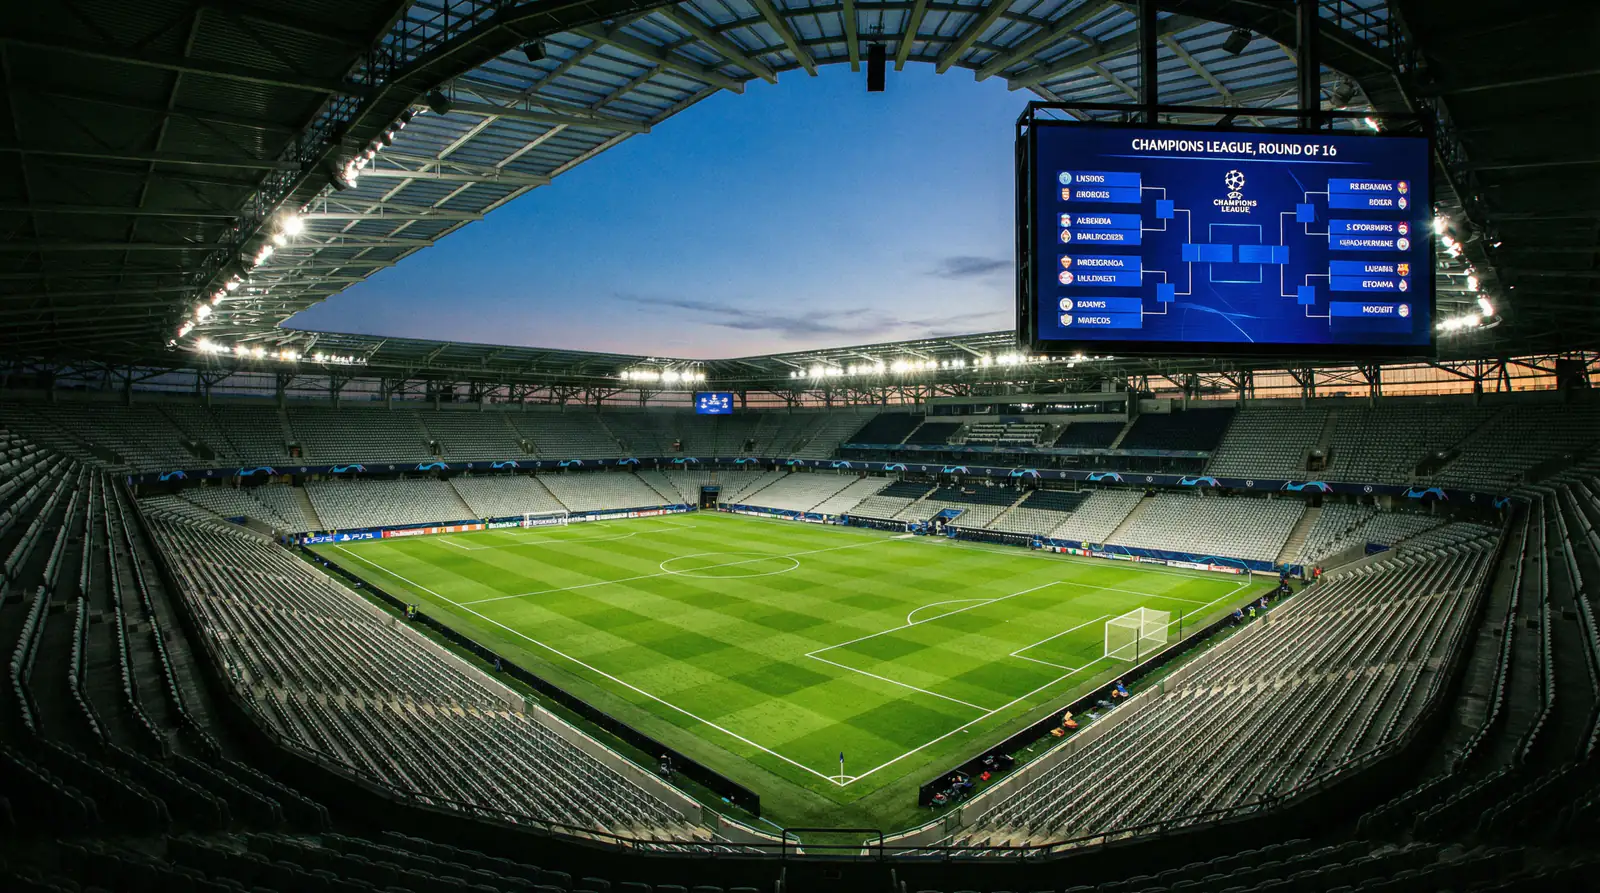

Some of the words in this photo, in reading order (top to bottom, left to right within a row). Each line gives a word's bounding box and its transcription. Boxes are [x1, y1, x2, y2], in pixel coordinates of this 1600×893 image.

[1131, 138, 1204, 153] CHAMPIONS
[1206, 141, 1257, 156] LEAGUE,
[1258, 142, 1302, 155] ROUND
[1303, 144, 1320, 156] OF
[1322, 145, 1337, 157] 16
[1213, 198, 1258, 207] CHAMPIONS
[352, 532, 374, 540] PS5
